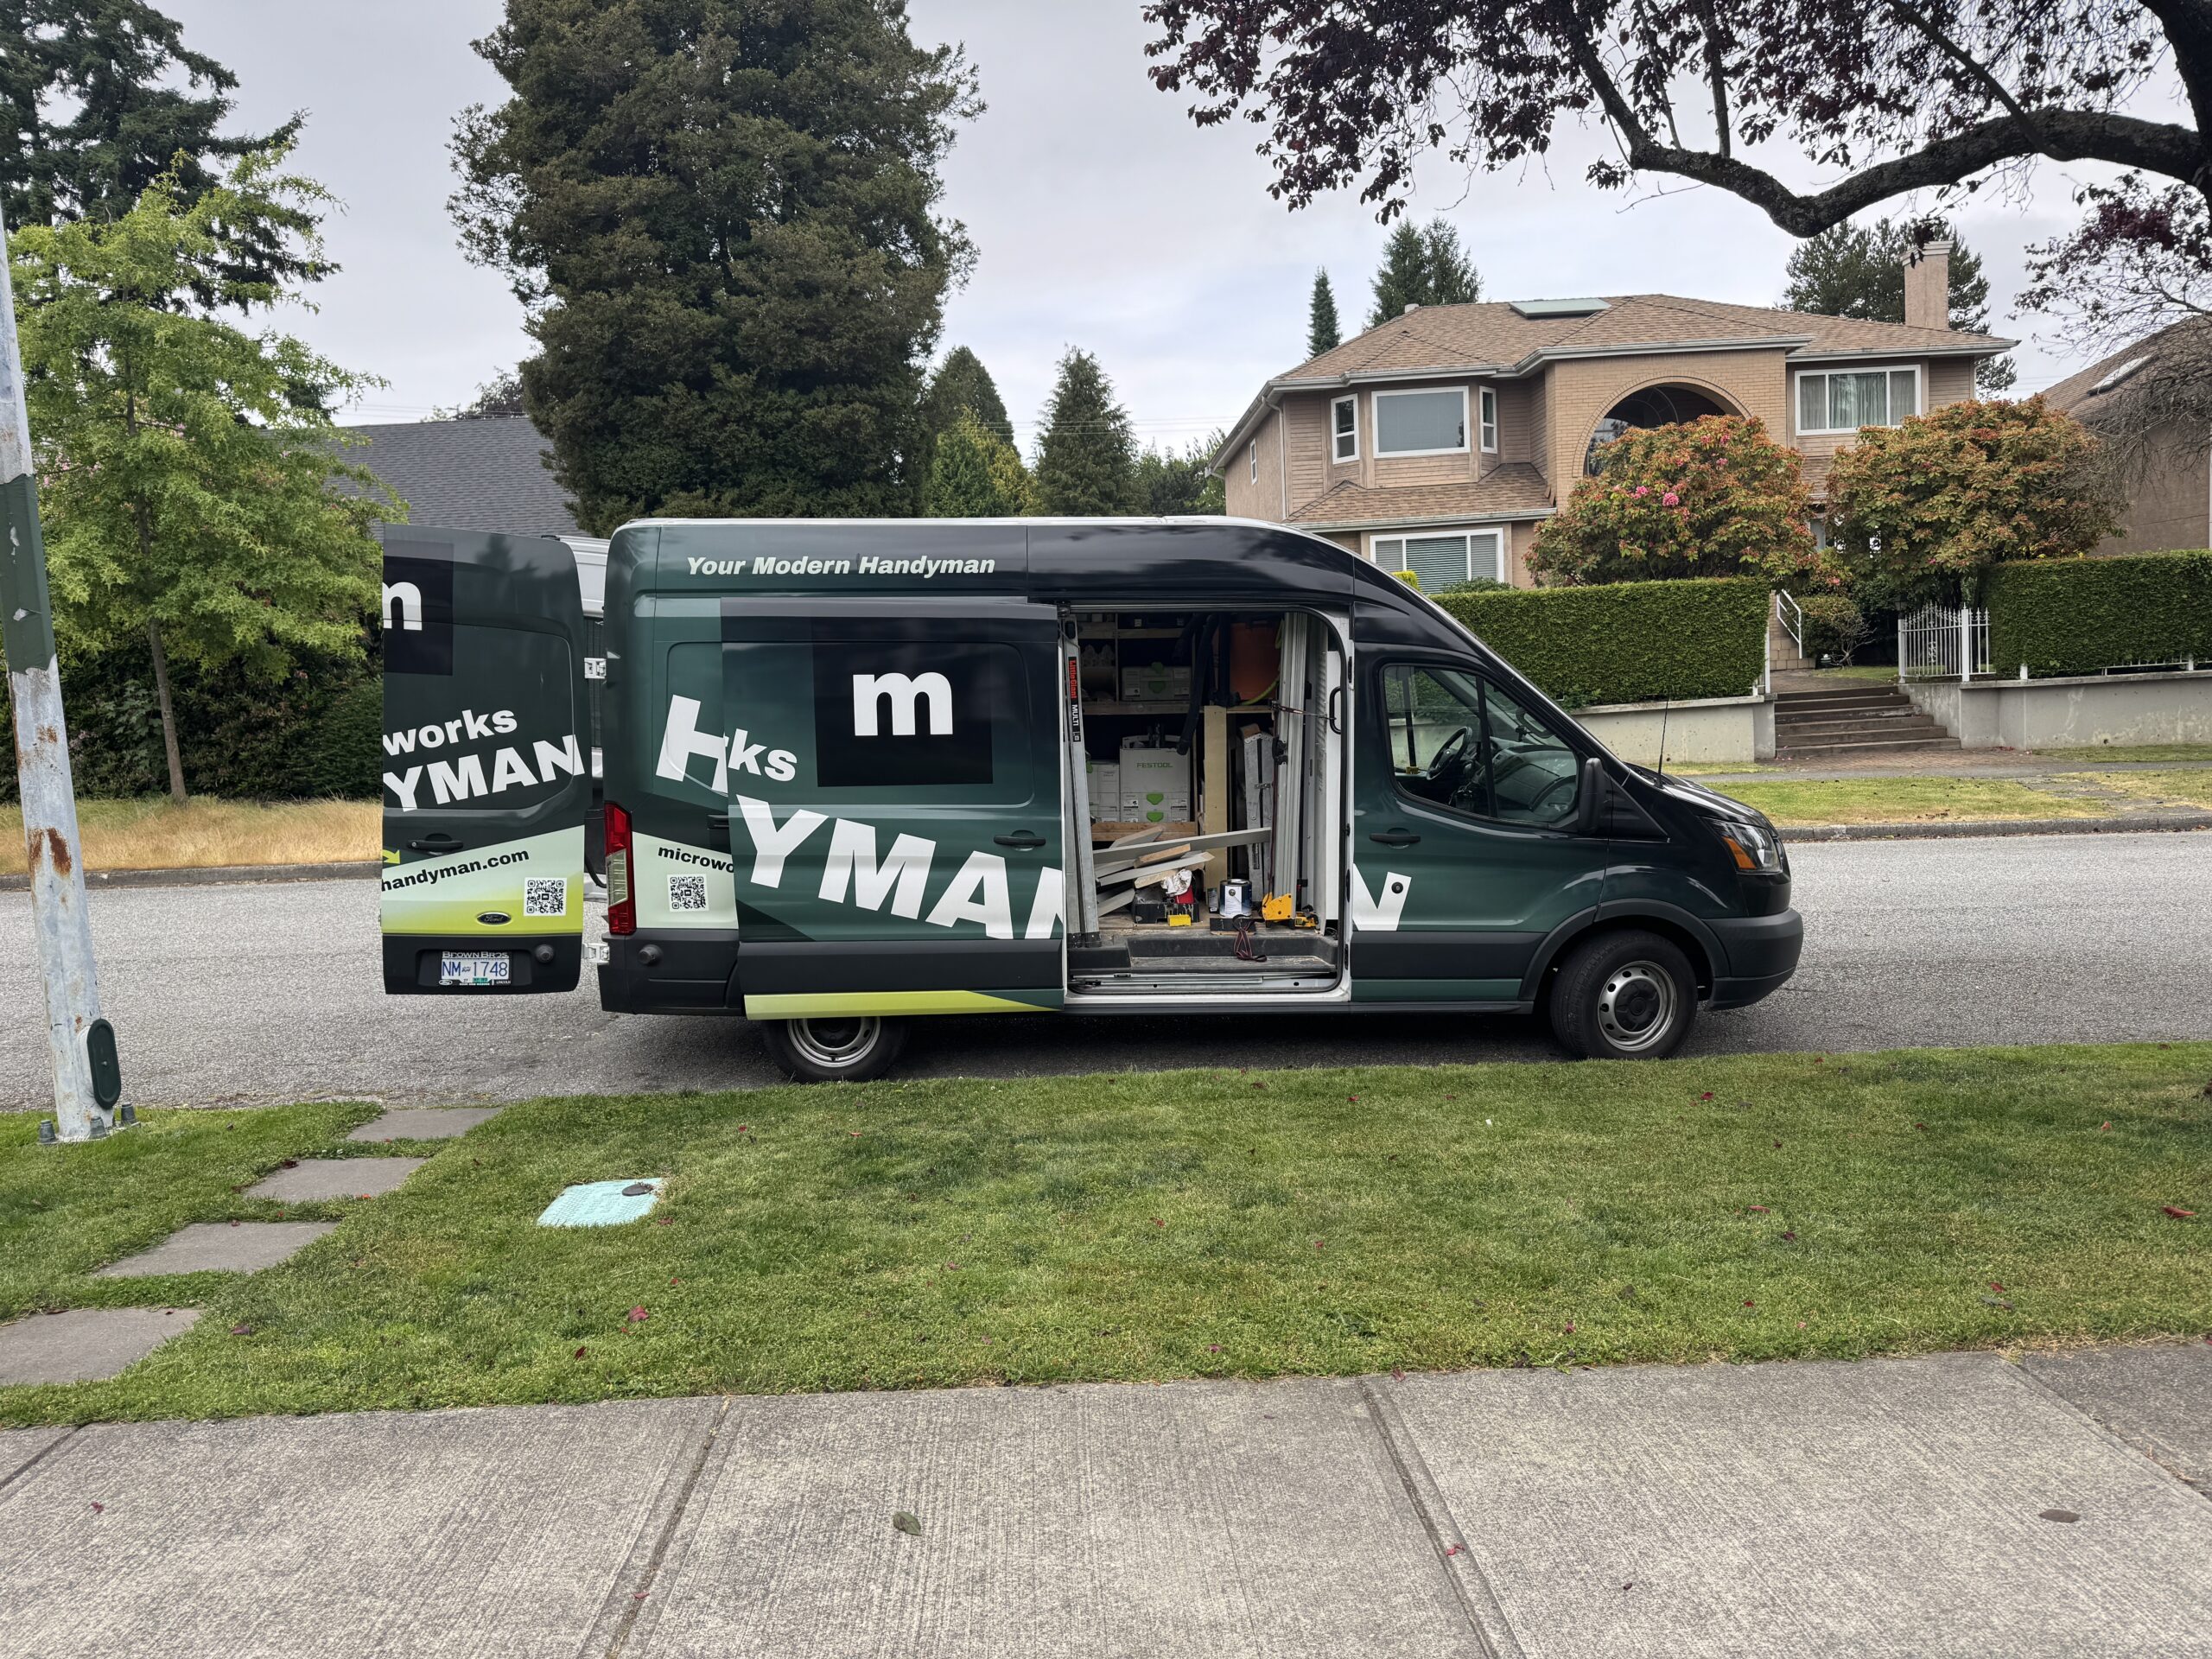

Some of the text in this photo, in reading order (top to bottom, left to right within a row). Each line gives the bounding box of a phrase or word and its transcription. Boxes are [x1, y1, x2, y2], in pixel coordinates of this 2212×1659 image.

[687, 556, 995, 578] Your Modern Handyman
[853, 671, 953, 736] m
[383, 709, 518, 756] works
[724, 728, 798, 782] ks
[383, 734, 585, 812] YMAN
[381, 850, 530, 892] handyman.com
